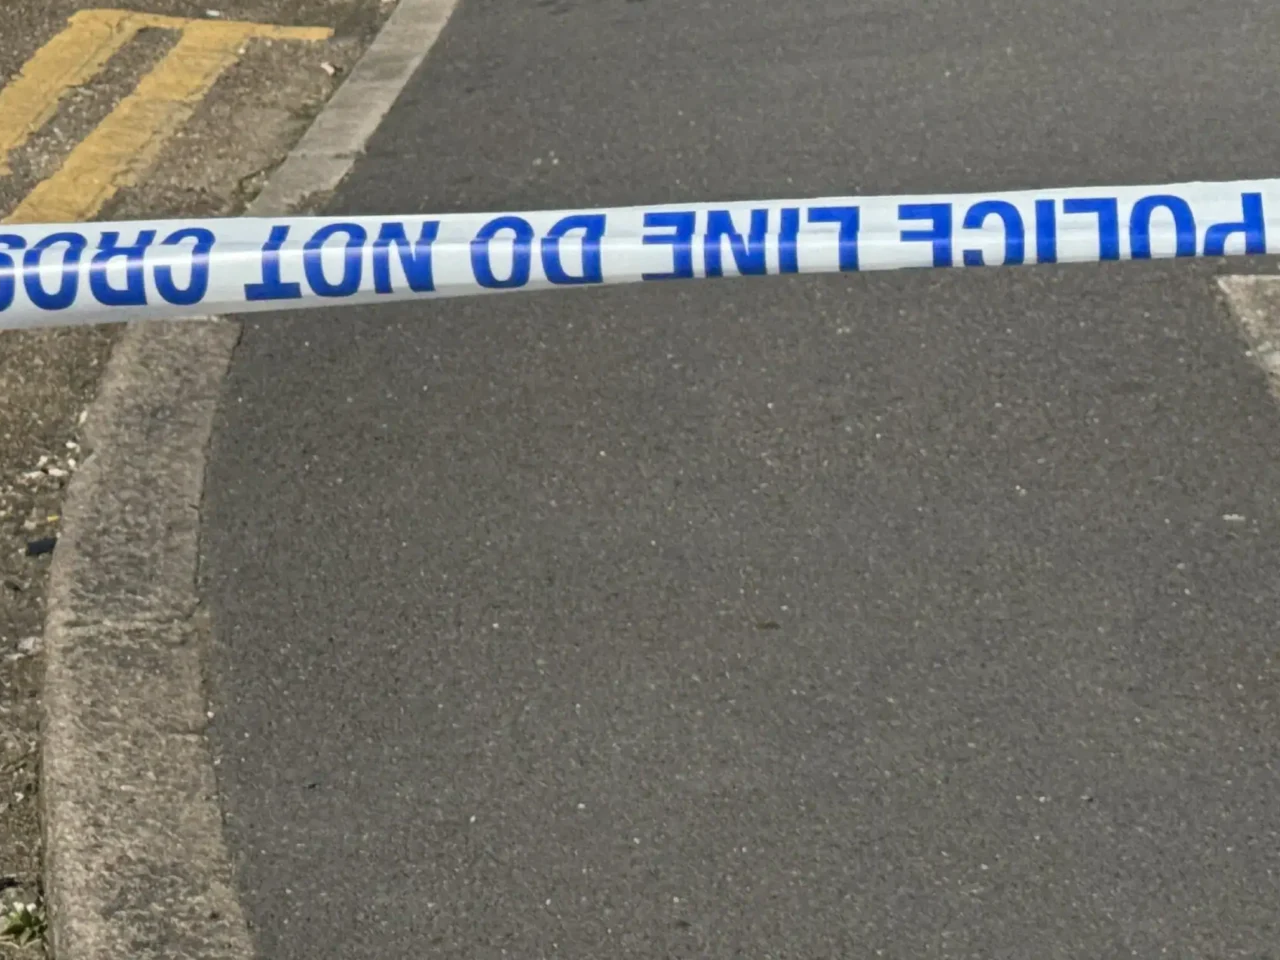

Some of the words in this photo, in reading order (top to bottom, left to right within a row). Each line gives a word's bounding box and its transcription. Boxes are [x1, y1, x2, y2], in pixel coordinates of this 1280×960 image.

[244, 220, 439, 301] NOT
[470, 214, 607, 286] DO
[642, 205, 861, 280] LINE
[898, 191, 1266, 267] POLICE
